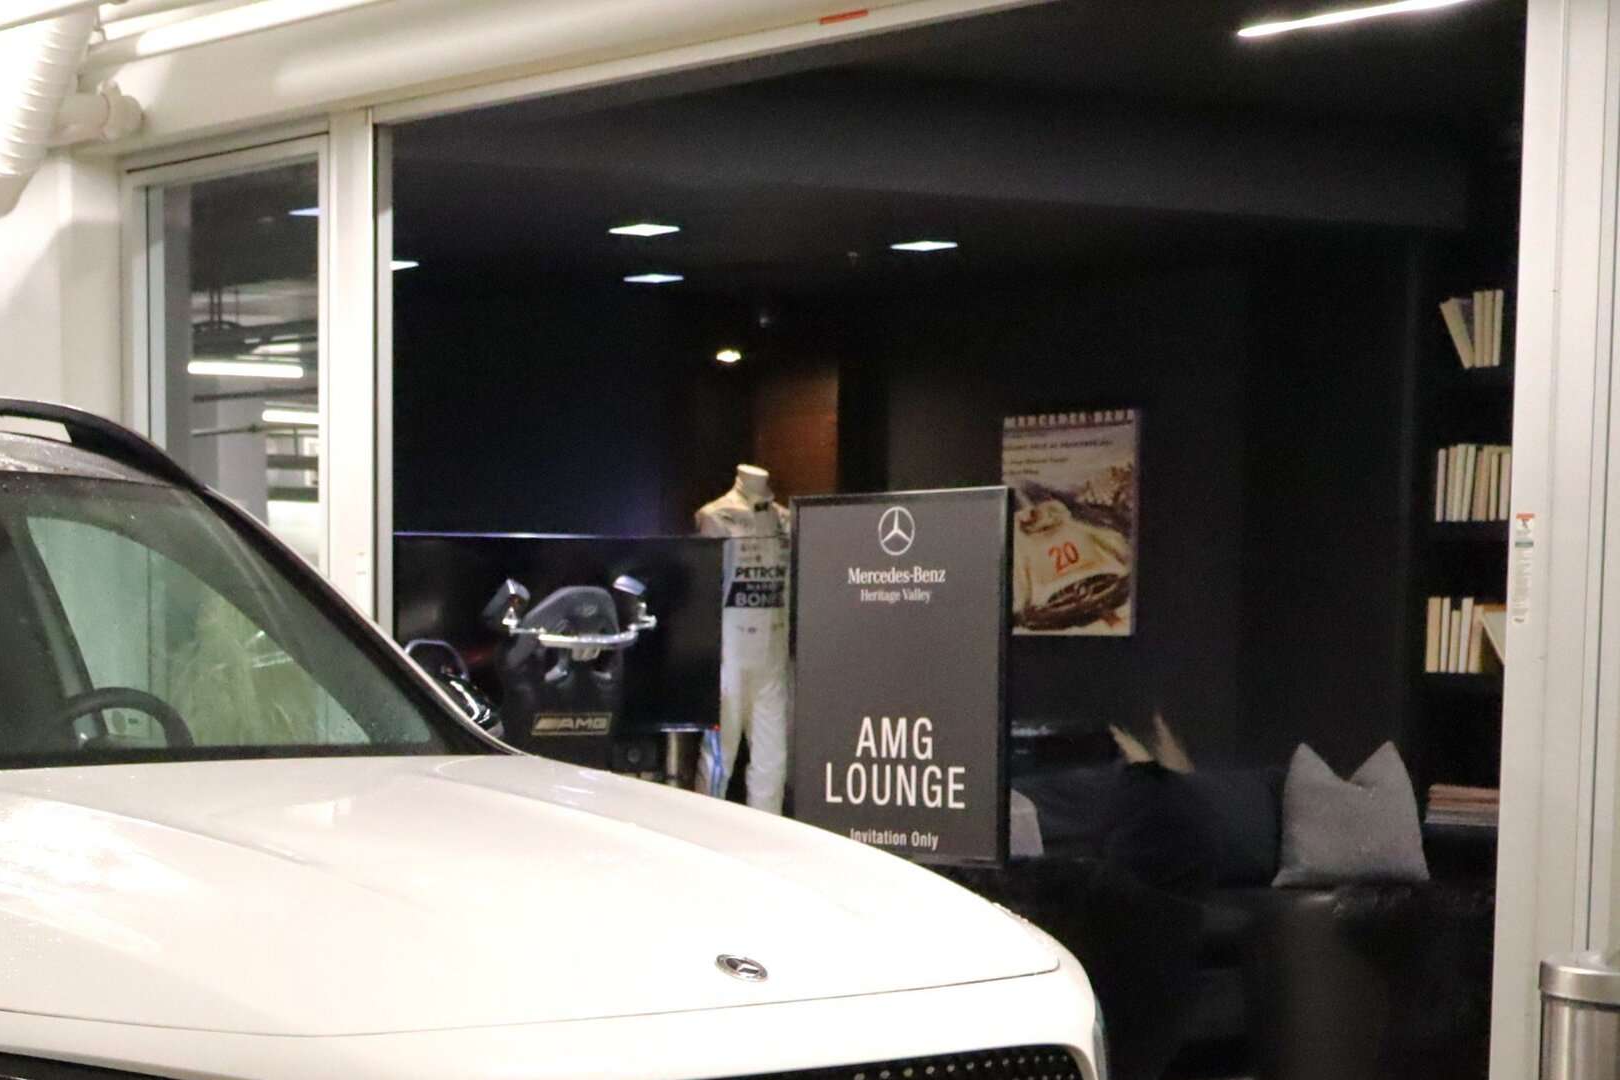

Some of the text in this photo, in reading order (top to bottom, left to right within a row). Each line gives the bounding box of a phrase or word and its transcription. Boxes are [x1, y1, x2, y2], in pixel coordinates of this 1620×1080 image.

[1047, 542, 1079, 575] 20
[848, 565, 946, 585] Mercedes-Benz
[860, 588, 932, 604] Heritage Valley
[855, 716, 933, 760] AMG
[825, 762, 966, 809] LOUNGE
[850, 828, 939, 850] Invitation Only
